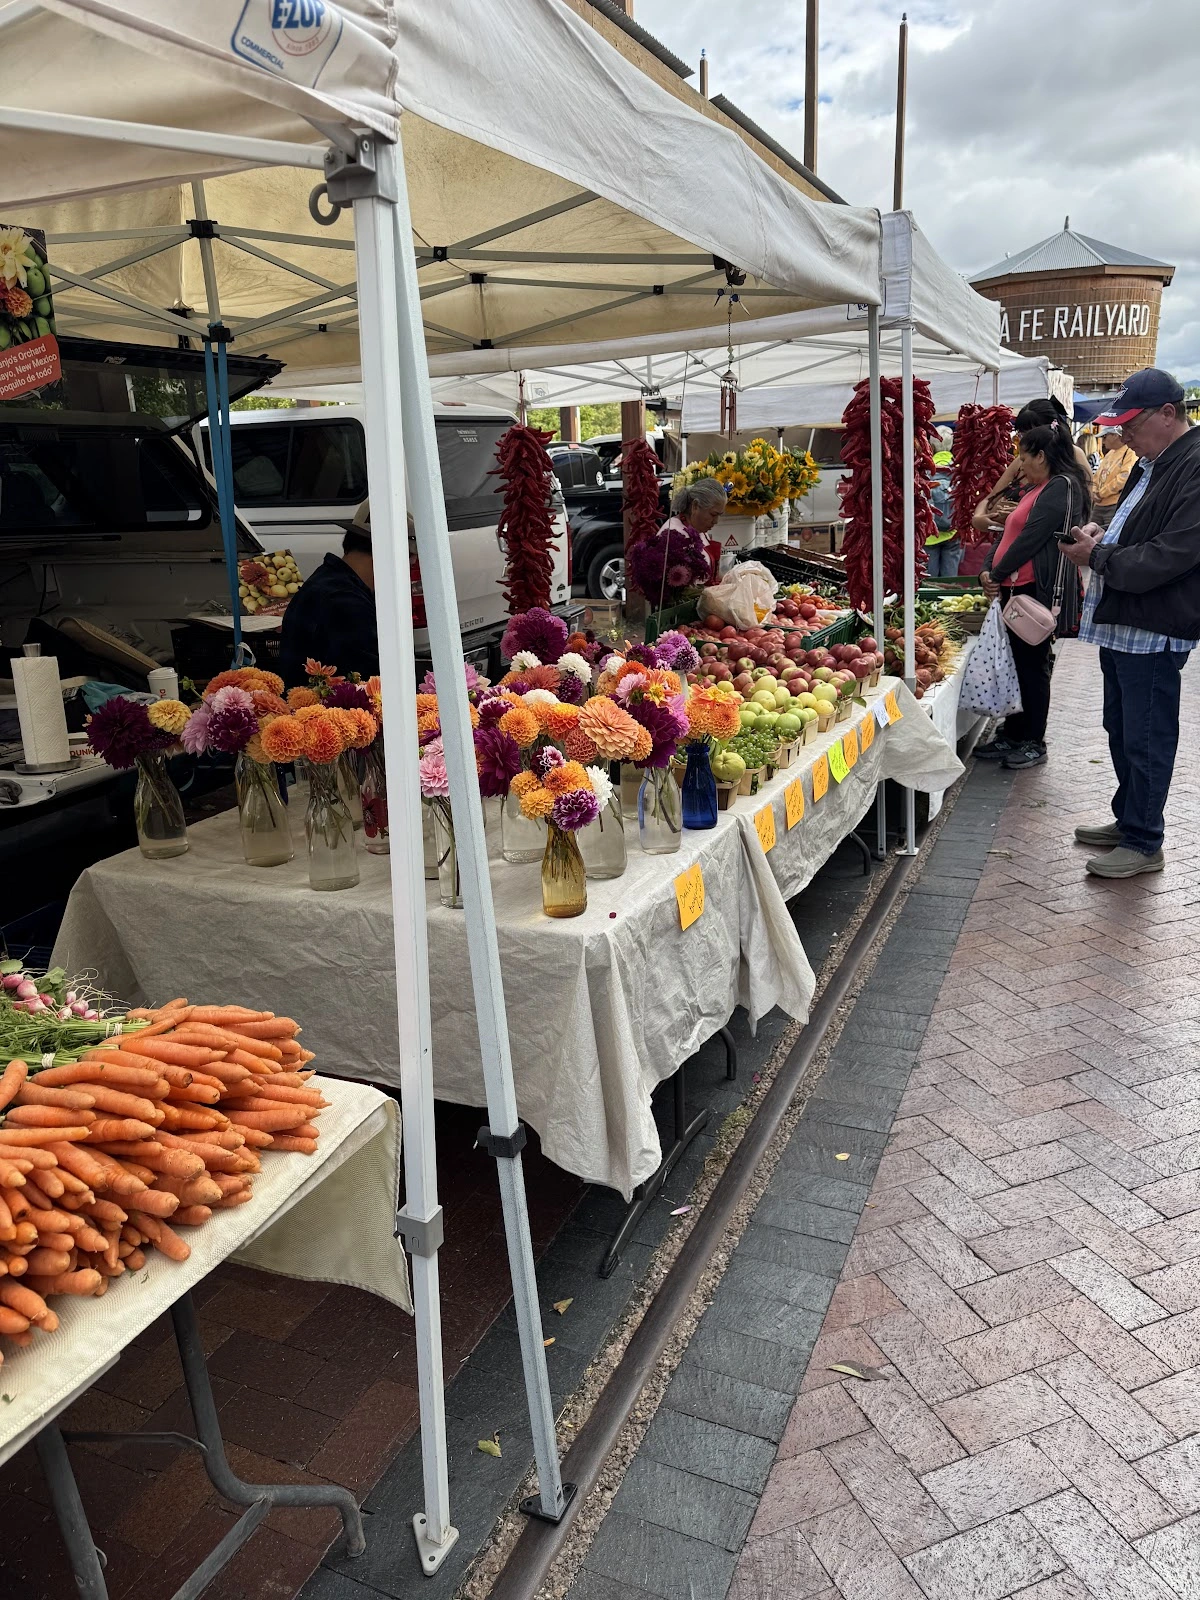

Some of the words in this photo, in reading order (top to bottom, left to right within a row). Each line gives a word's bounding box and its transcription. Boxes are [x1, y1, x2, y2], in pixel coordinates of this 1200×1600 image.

[241, 36, 285, 70] COMMERCIAL
[1019, 309, 1045, 342] FE
[1053, 304, 1150, 339] RAILYARD
[0, 355, 18, 369] anjo's
[18, 343, 46, 361] Orchard
[0, 369, 16, 381] ayo,
[15, 363, 32, 375] New
[32, 353, 58, 368] Mexico
[0, 378, 26, 396] poquito
[26, 373, 36, 383] de
[70, 748, 94, 757] DUNK
